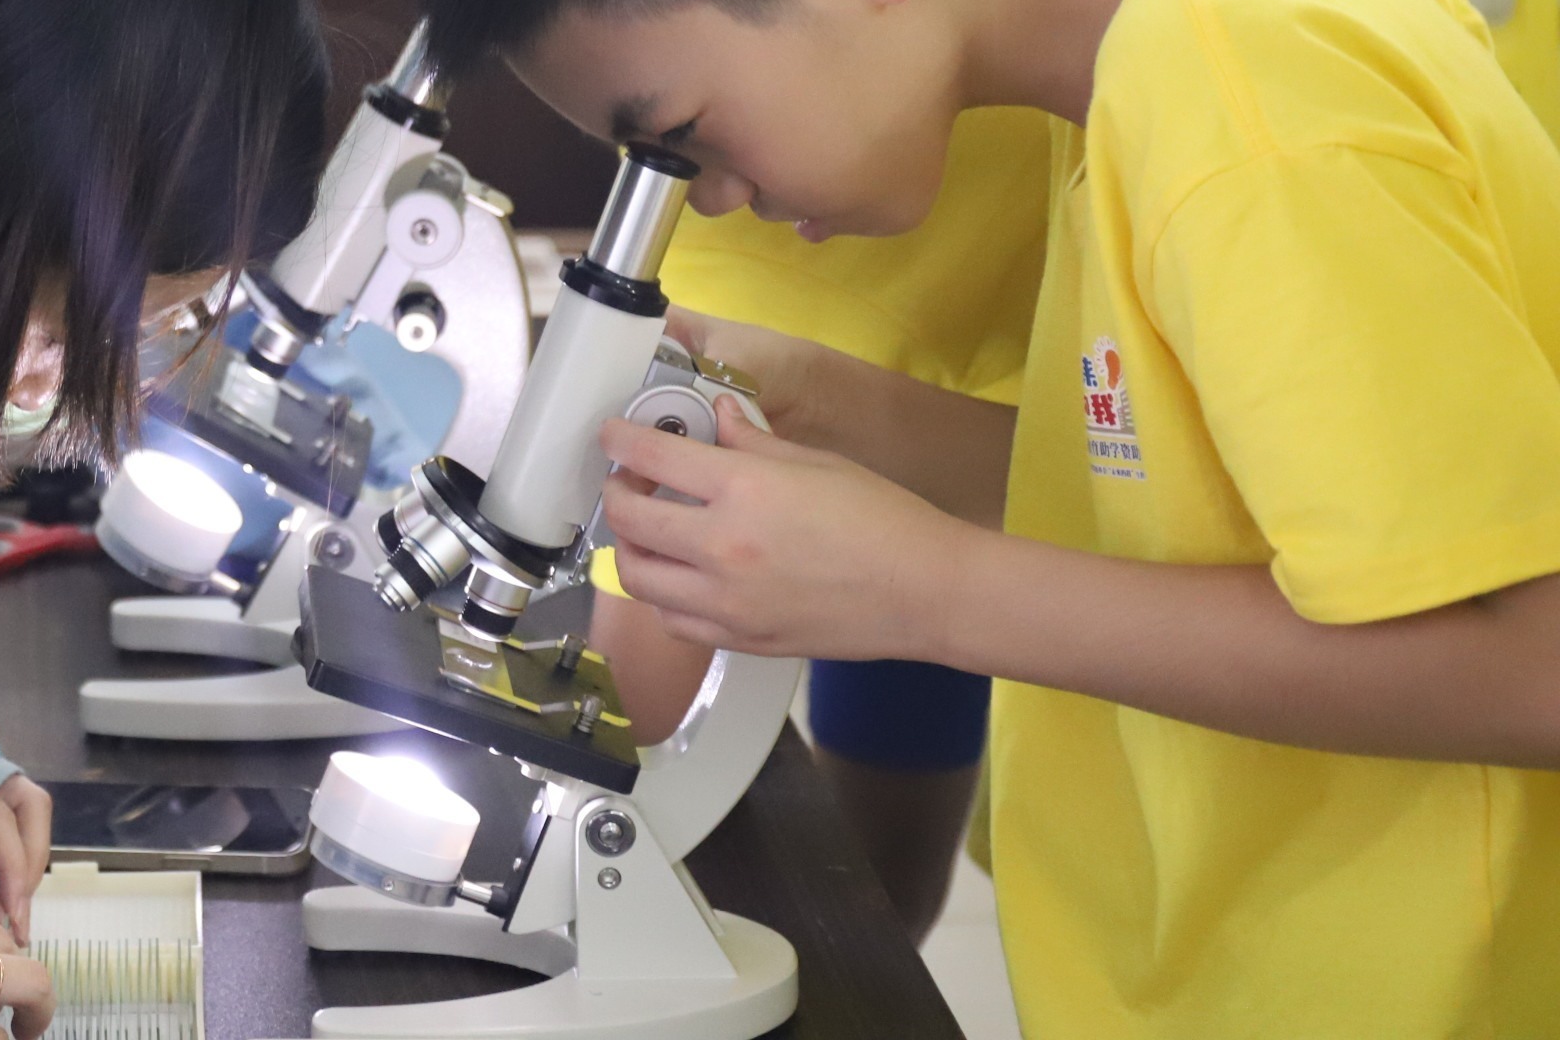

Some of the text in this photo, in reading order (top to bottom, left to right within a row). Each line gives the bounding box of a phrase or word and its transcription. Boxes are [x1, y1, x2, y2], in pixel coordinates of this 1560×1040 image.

[1088, 440, 1142, 461] 育助学资助
